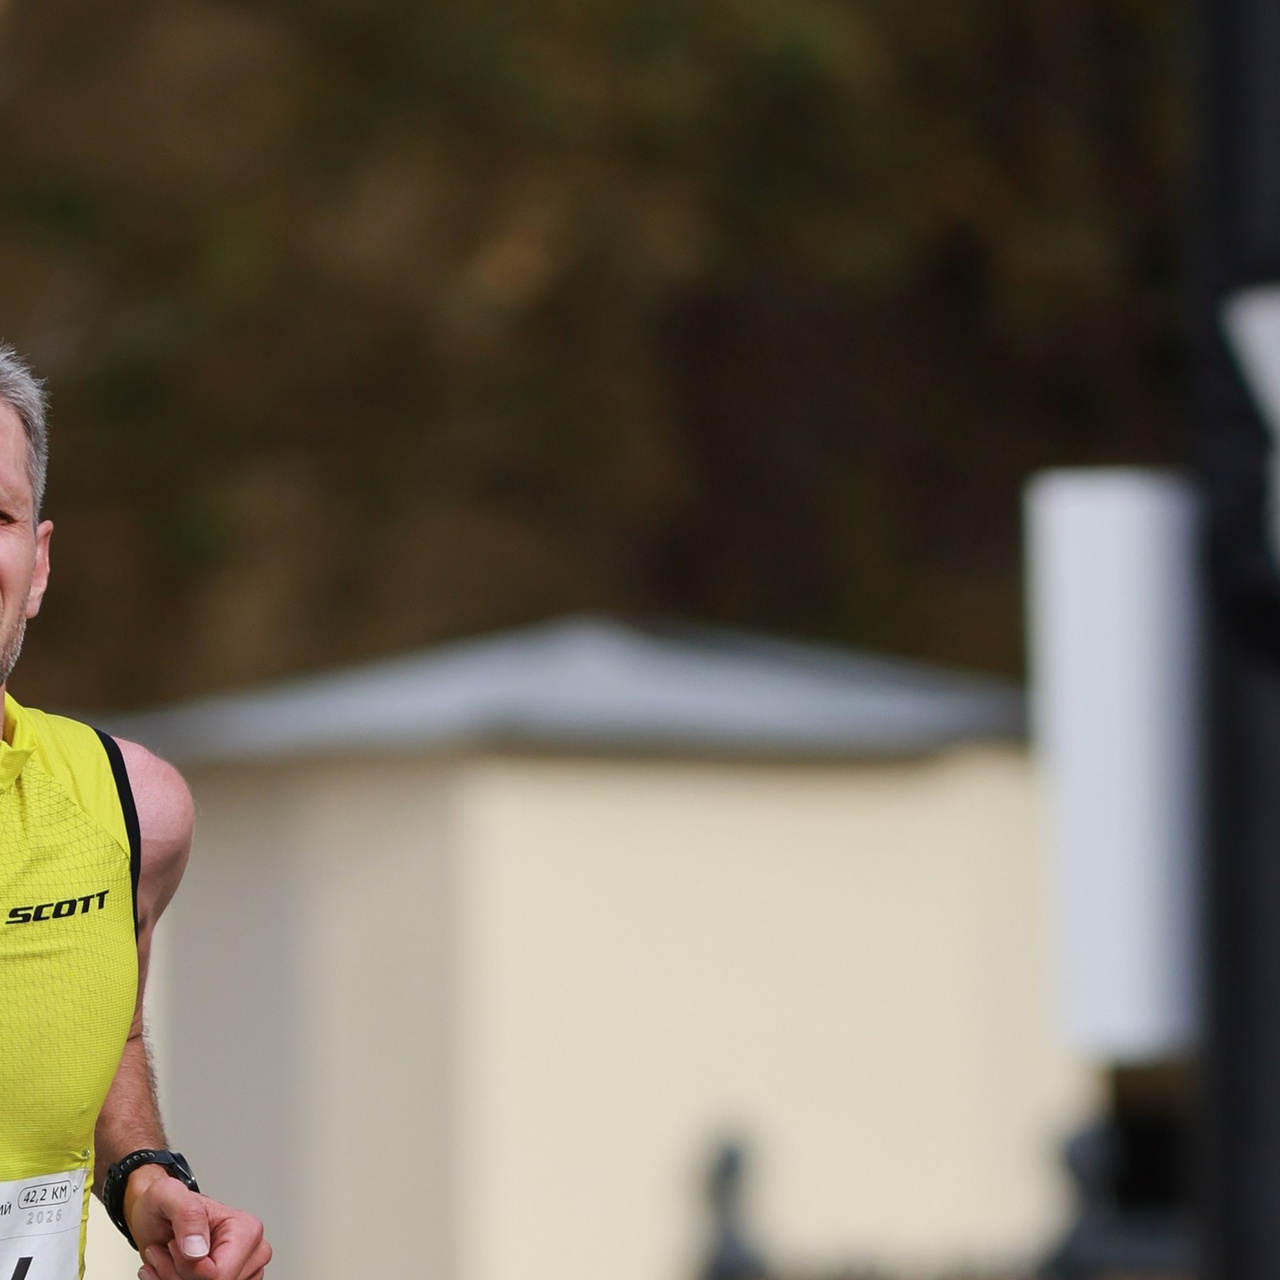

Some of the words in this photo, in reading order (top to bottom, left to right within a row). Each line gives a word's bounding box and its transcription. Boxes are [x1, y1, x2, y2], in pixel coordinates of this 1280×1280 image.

[5, 890, 109, 924] SCOTT
[24, 1188, 48, 1203] 42,2
[51, 1185, 67, 1200] КМ
